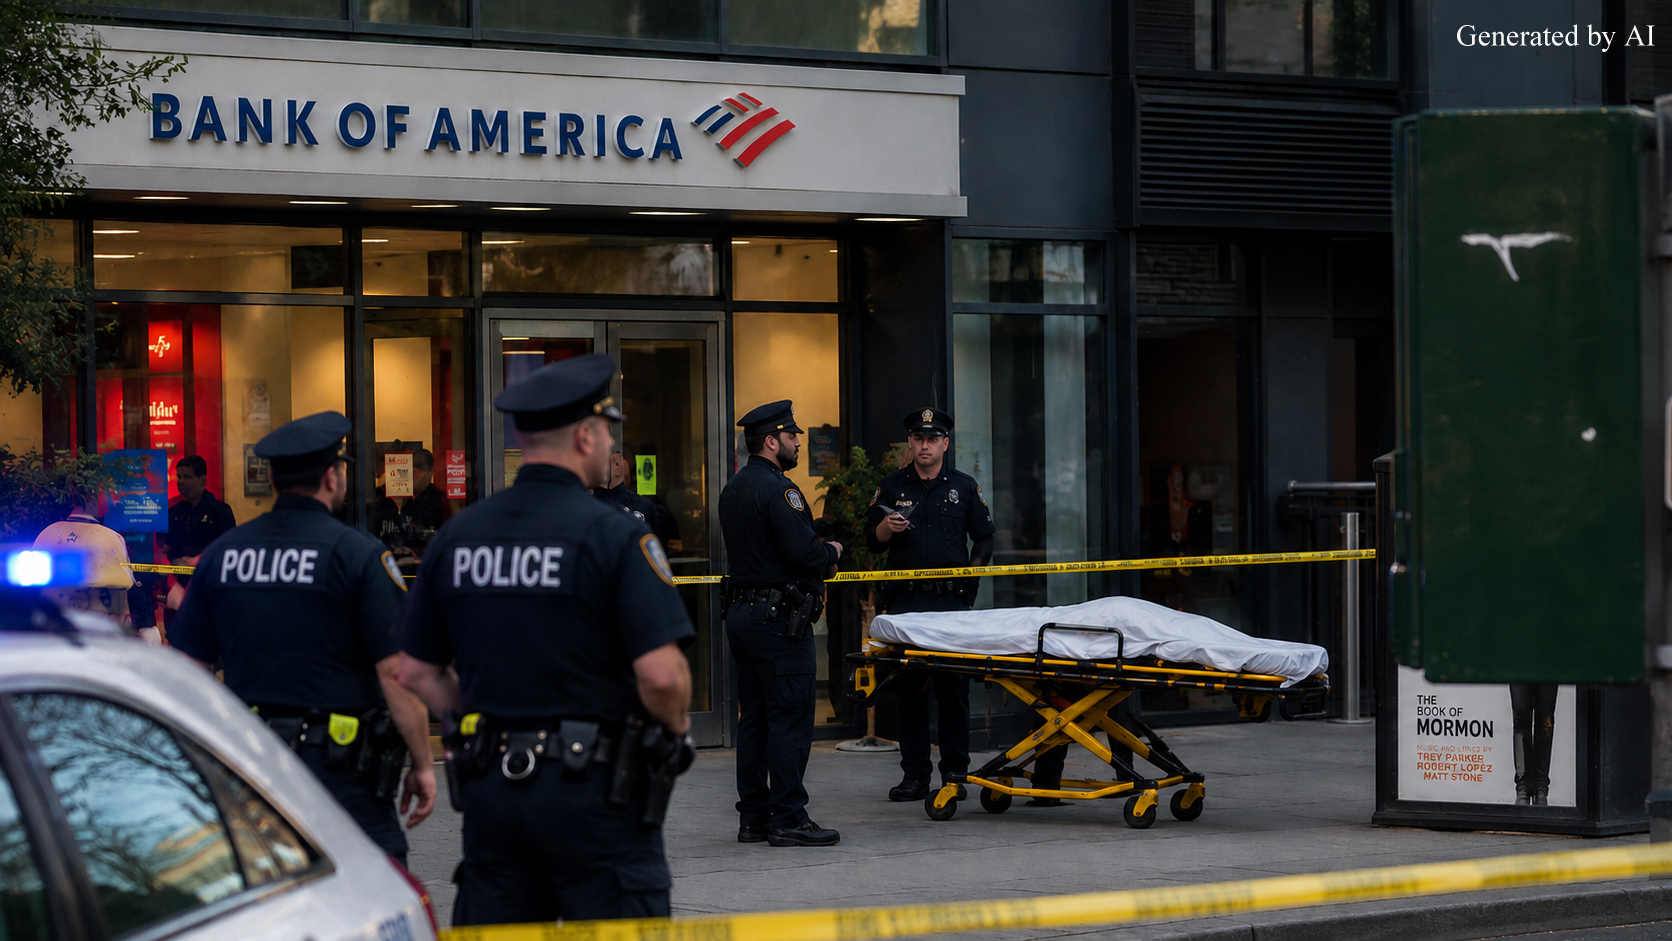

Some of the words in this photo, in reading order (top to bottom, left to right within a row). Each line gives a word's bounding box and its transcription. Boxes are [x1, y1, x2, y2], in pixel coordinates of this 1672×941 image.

[150, 92, 320, 146] BANK
[335, 101, 411, 150] OF
[424, 107, 683, 160] AMERICA
[219, 548, 319, 585] POLICE
[452, 545, 564, 589] POLICE
[1416, 694, 1437, 705] THE
[1417, 706, 1446, 717] BOOK
[1449, 707, 1463, 717] OF
[1417, 718, 1494, 738] MORMON
[1417, 752, 1442, 761] TREY
[1445, 753, 1484, 763] PARKER
[1423, 772, 1449, 781] MATT
[1451, 773, 1483, 782] STONE
